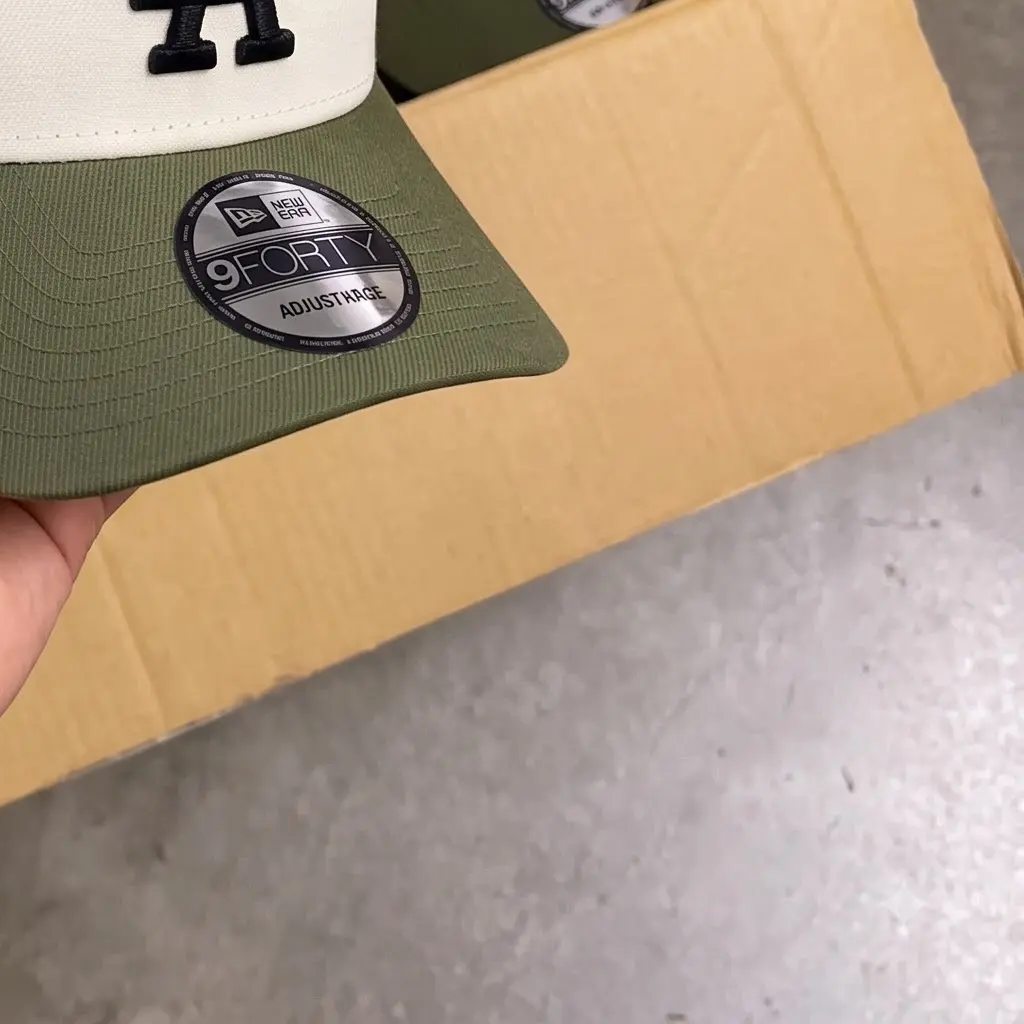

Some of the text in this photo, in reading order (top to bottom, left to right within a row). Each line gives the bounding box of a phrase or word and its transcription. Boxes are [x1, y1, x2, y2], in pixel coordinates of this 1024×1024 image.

[269, 196, 305, 211] NEW
[277, 207, 312, 220] ERA
[206, 232, 378, 292] 9FORTY
